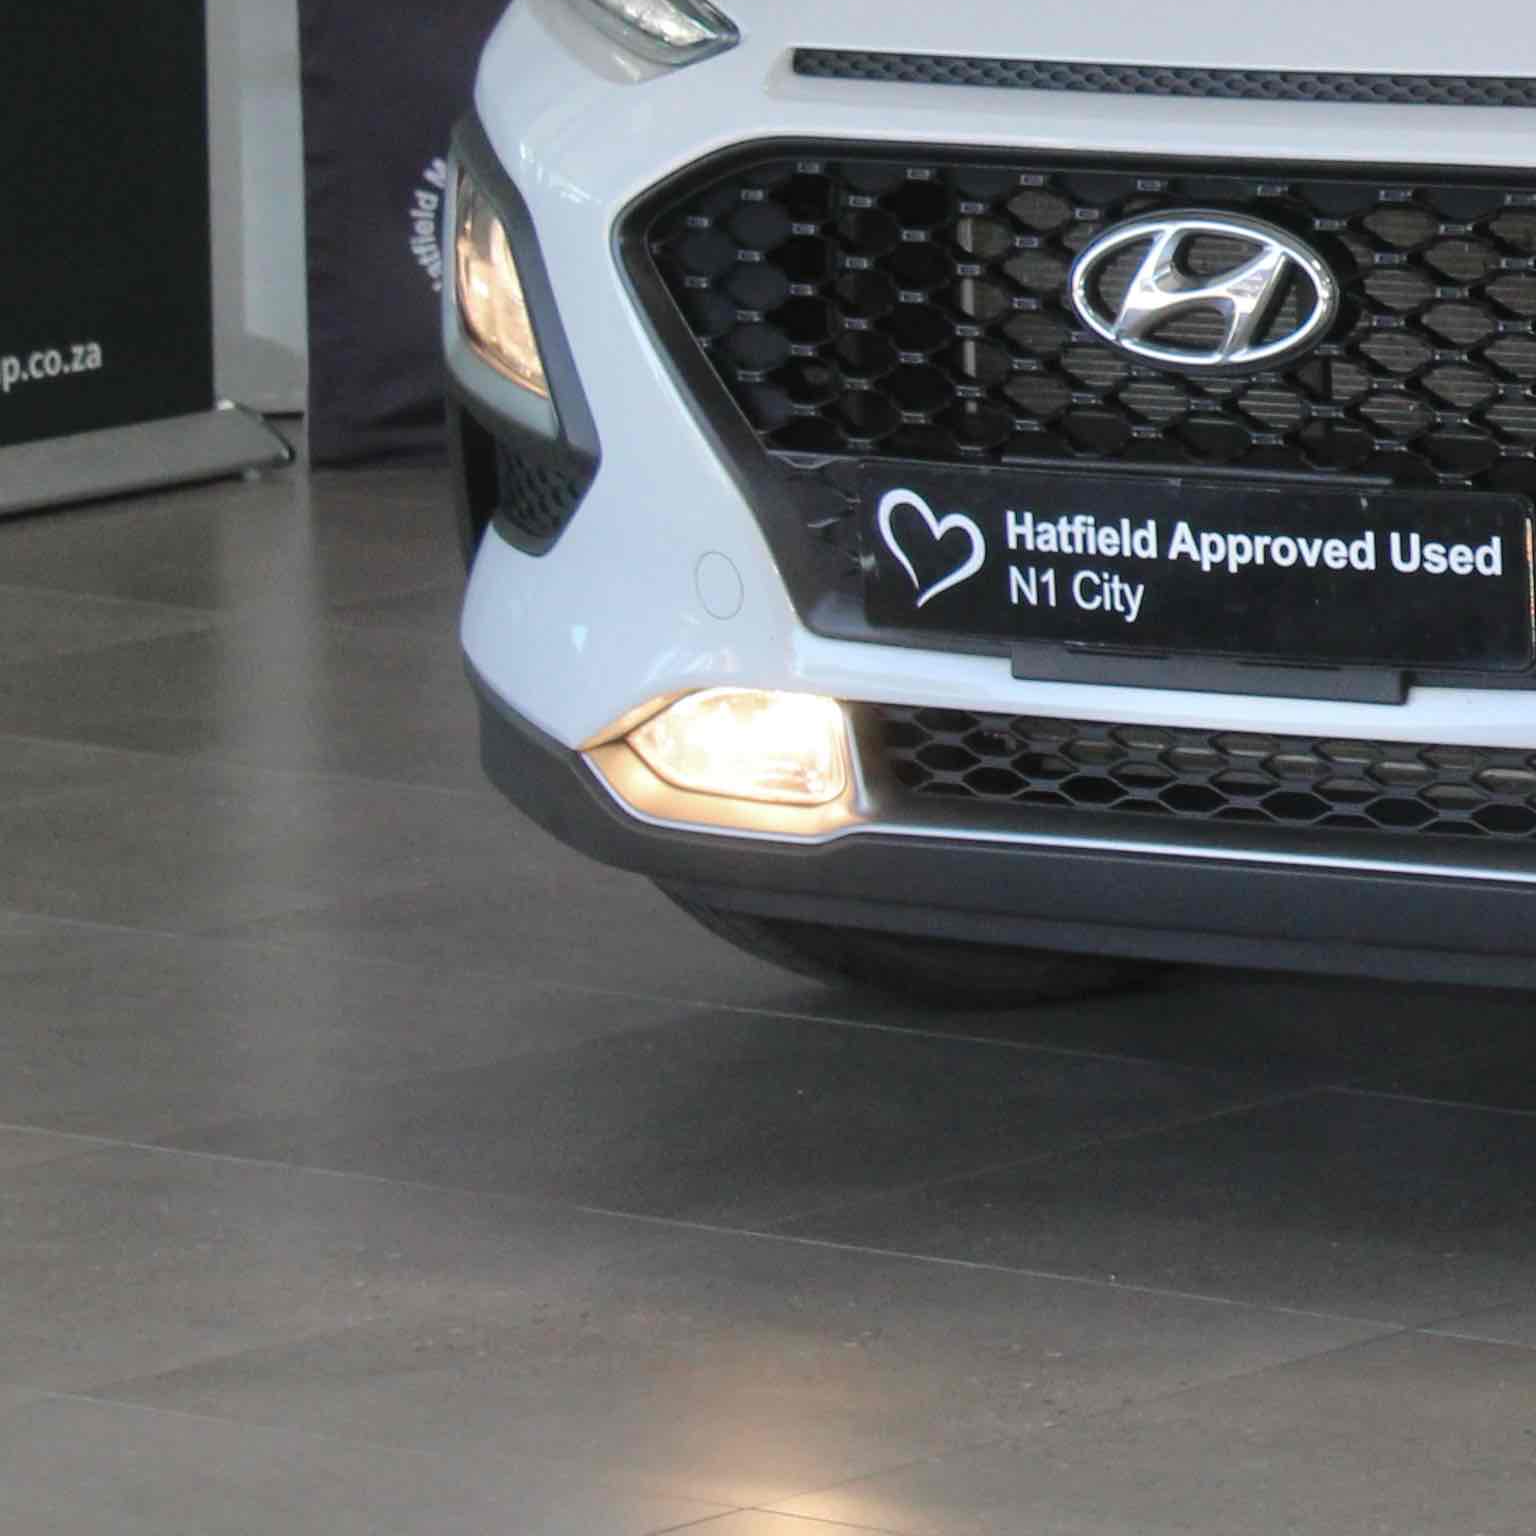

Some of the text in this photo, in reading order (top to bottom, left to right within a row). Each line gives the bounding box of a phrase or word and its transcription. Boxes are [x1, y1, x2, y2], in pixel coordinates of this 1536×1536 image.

[0, 342, 103, 393] p.co.za
[1006, 510, 1502, 576] Hatfield Approved Used
[1009, 565, 1145, 623] N1 City
